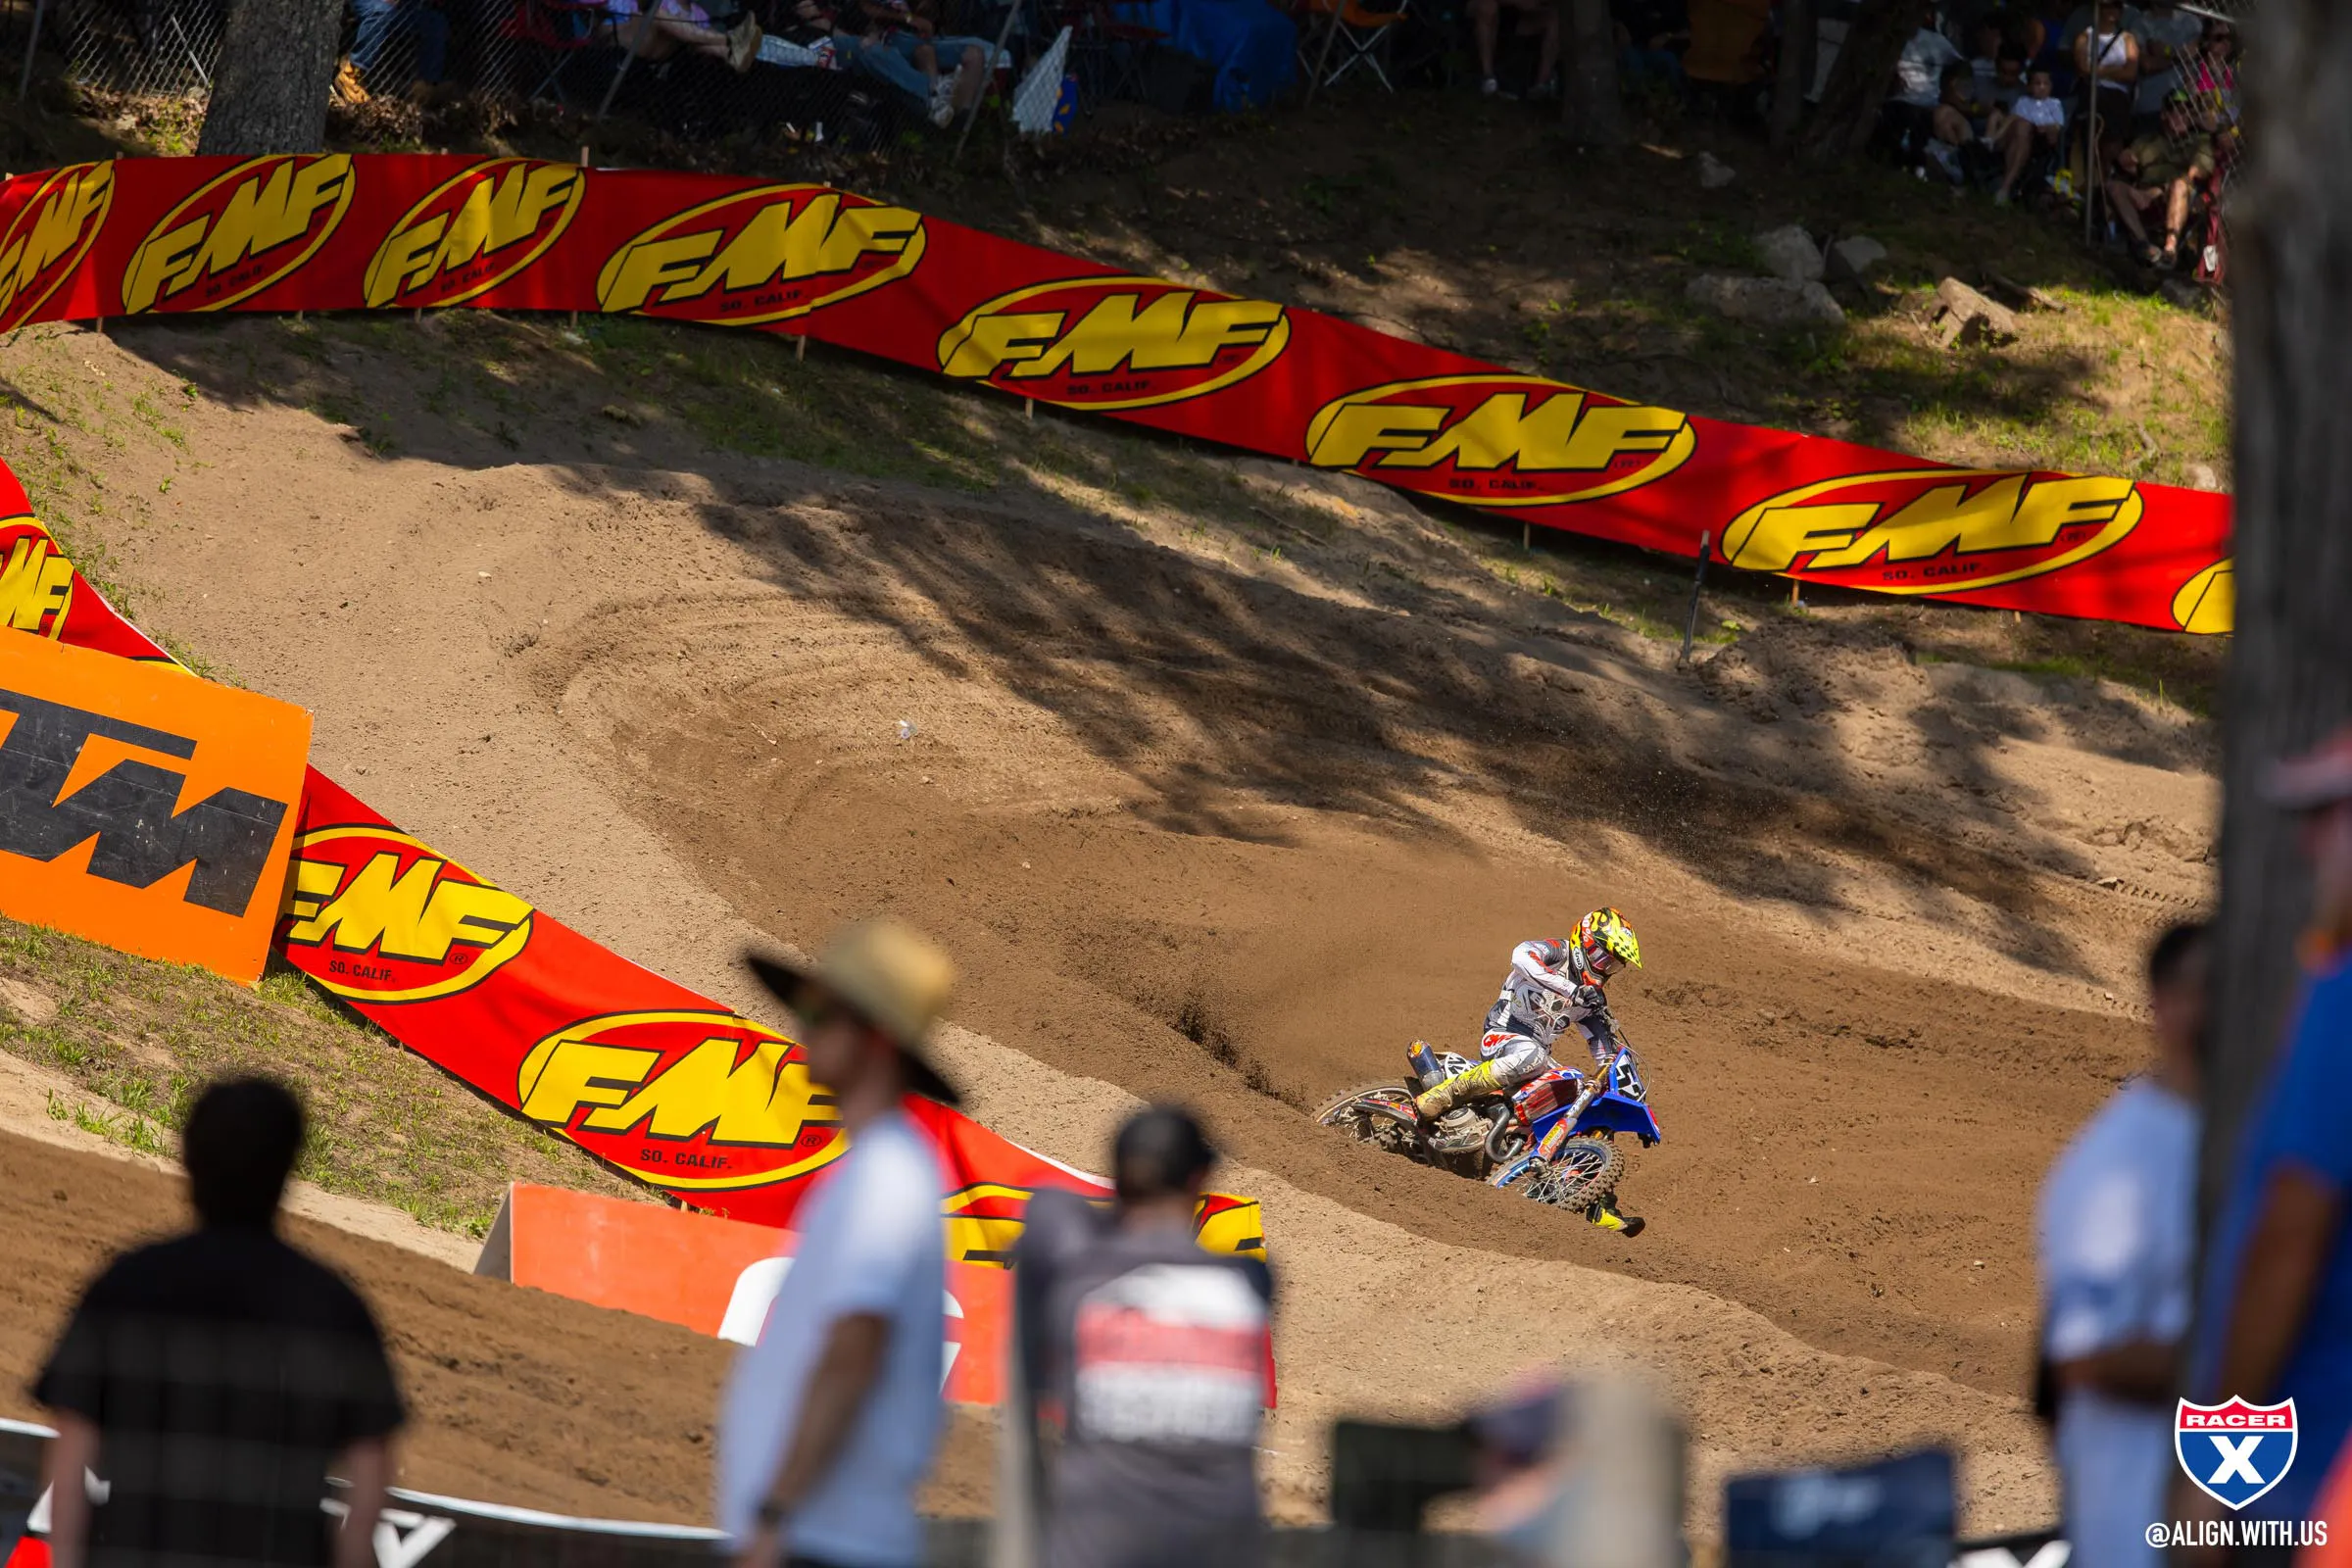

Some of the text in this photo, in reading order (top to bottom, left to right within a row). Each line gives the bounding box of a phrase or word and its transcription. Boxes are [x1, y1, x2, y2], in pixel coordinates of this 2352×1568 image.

[125, 154, 352, 315] FMF
[365, 162, 579, 308] FMF
[601, 192, 922, 314] FMF
[942, 291, 1285, 380] FMF
[1308, 392, 1687, 472] FMF
[1731, 472, 2135, 571] FMF
[0, 535, 74, 636] MF
[0, 690, 288, 918] TM
[329, 960, 397, 983] SO. CALIF.
[521, 1036, 848, 1150] FMF
[641, 1149, 733, 1169] SO. CALIF.
